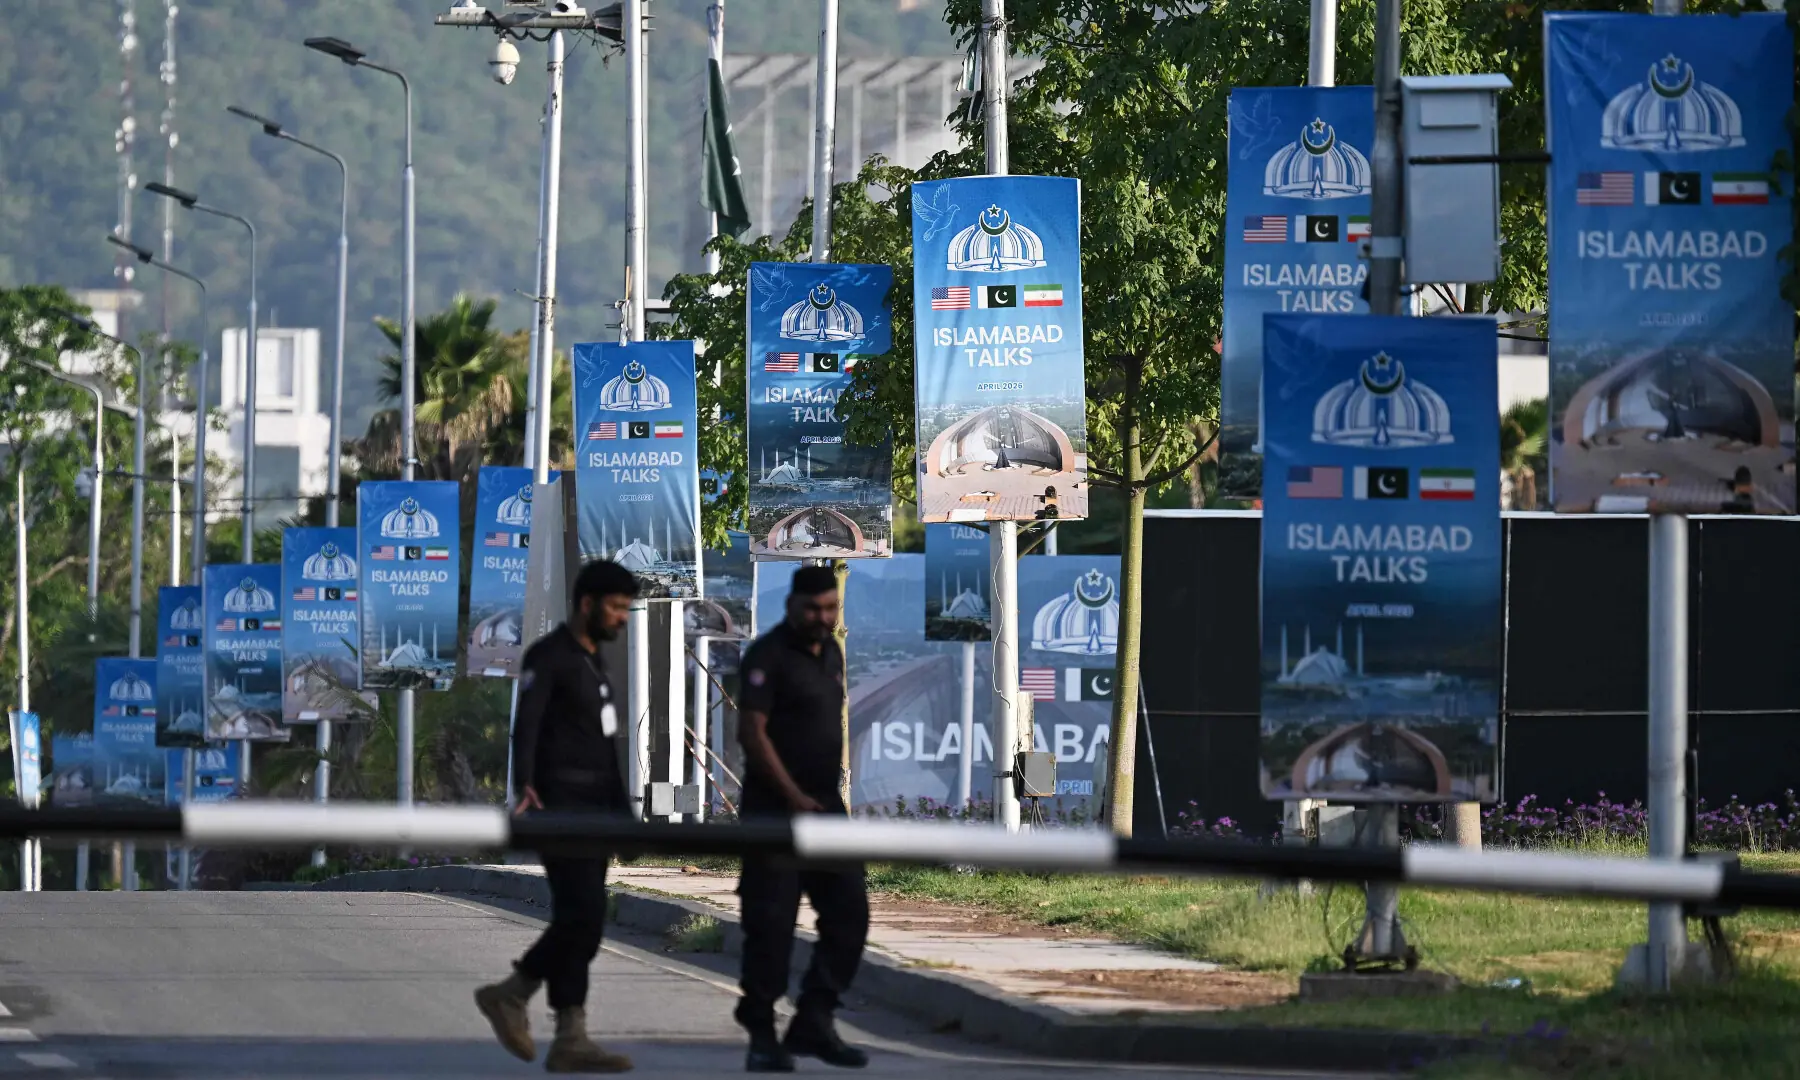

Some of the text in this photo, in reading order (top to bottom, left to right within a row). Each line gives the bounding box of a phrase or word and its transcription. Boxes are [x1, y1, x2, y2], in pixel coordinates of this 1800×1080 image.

[1578, 230, 1767, 258] ISLAMABAD
[1243, 263, 1368, 287] ISLAMABA
[1623, 262, 1722, 290] TALKS
[1276, 290, 1354, 313] TALKS
[933, 325, 1063, 346] ISLAMABAD
[964, 347, 1033, 367] TALKS
[977, 382, 1023, 391] APRIL 2026
[589, 451, 682, 467] ISLAMABAD
[611, 469, 660, 483] TALKS
[1287, 523, 1473, 551] ISLAMABAD
[484, 556, 526, 569] ISLAM
[1331, 556, 1428, 583] TALKS
[372, 570, 448, 582] ISLAMABAD
[502, 570, 526, 583] TAL
[389, 584, 429, 596] TALKS
[293, 609, 357, 621] ISLAMABA
[310, 622, 349, 634] TALKS
[232, 650, 267, 662] TALKS
